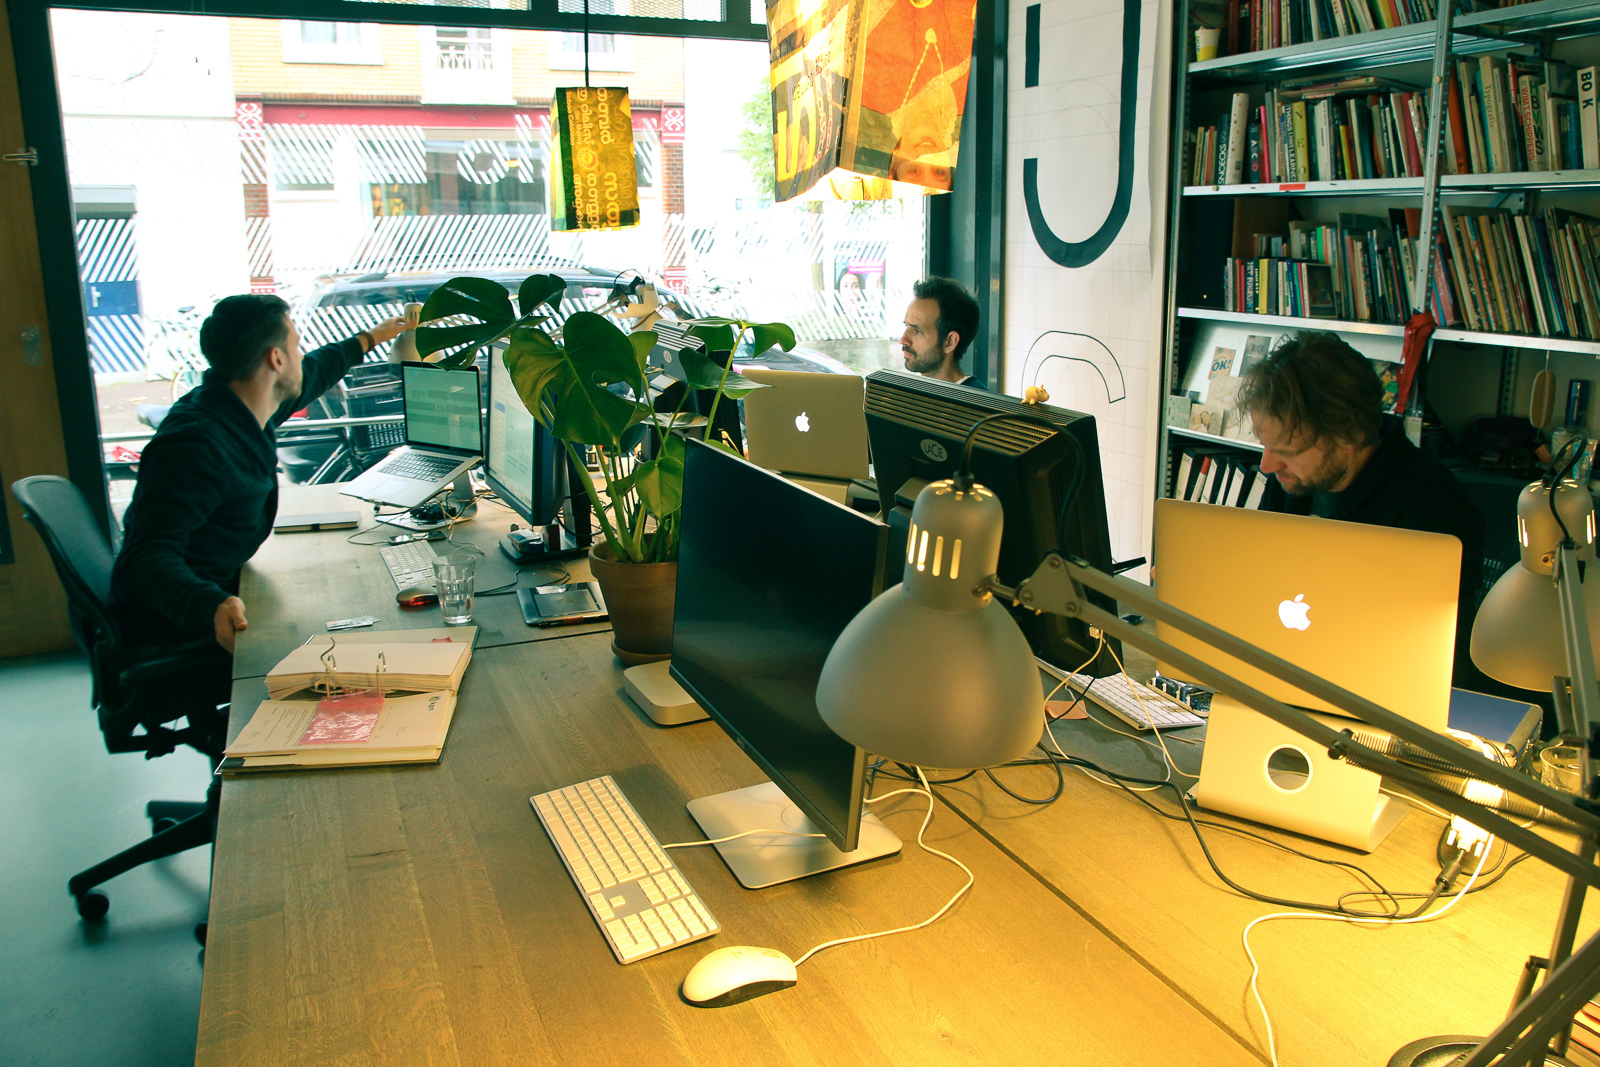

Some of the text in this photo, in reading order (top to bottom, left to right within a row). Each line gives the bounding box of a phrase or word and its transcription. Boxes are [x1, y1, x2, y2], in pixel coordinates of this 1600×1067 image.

[1285, 106, 1293, 132] THINGS
[1484, 84, 1496, 128] Typografie
[1217, 144, 1227, 185] SNOECKS
